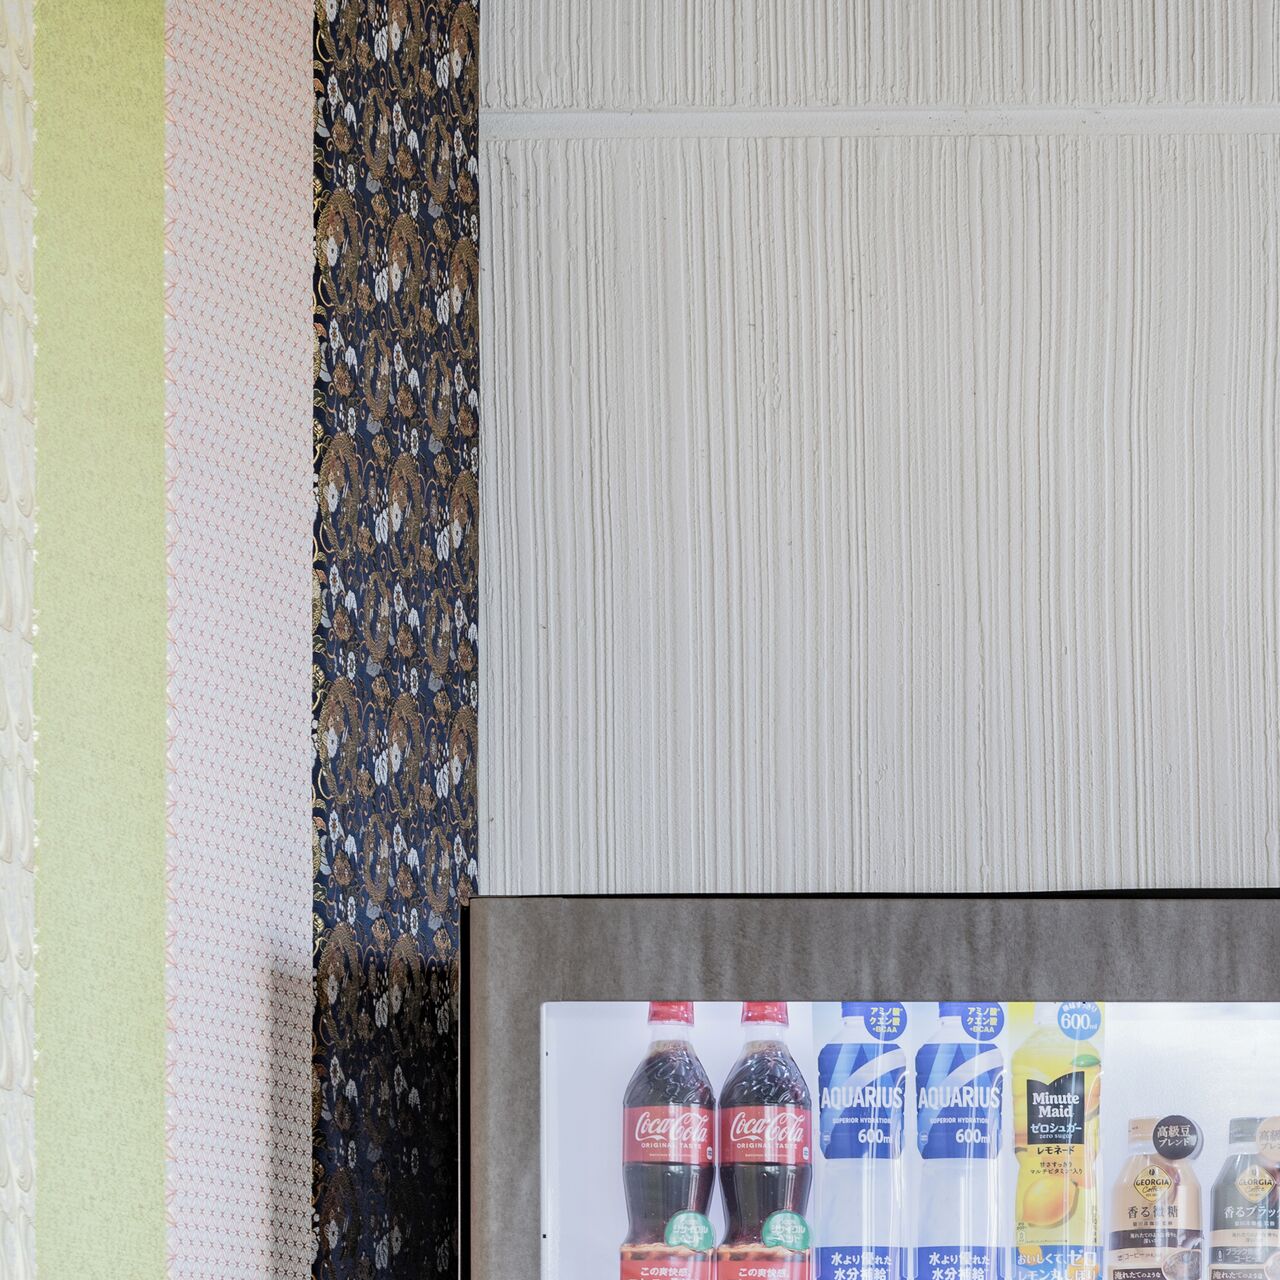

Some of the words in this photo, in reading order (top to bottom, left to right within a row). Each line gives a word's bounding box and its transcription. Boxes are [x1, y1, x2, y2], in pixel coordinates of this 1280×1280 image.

[821, 1087, 903, 1109] AQUARIUS
[918, 1087, 1000, 1109] AQUARIUS
[1032, 1092, 1080, 1105] Minute
[1038, 1105, 1073, 1118] Maid
[1030, 1123, 1082, 1133] ゼロシュガー
[1157, 1125, 1191, 1137] 高級豆
[1037, 1146, 1074, 1155] レモネード
[1135, 1178, 1170, 1187] GEORGIA
